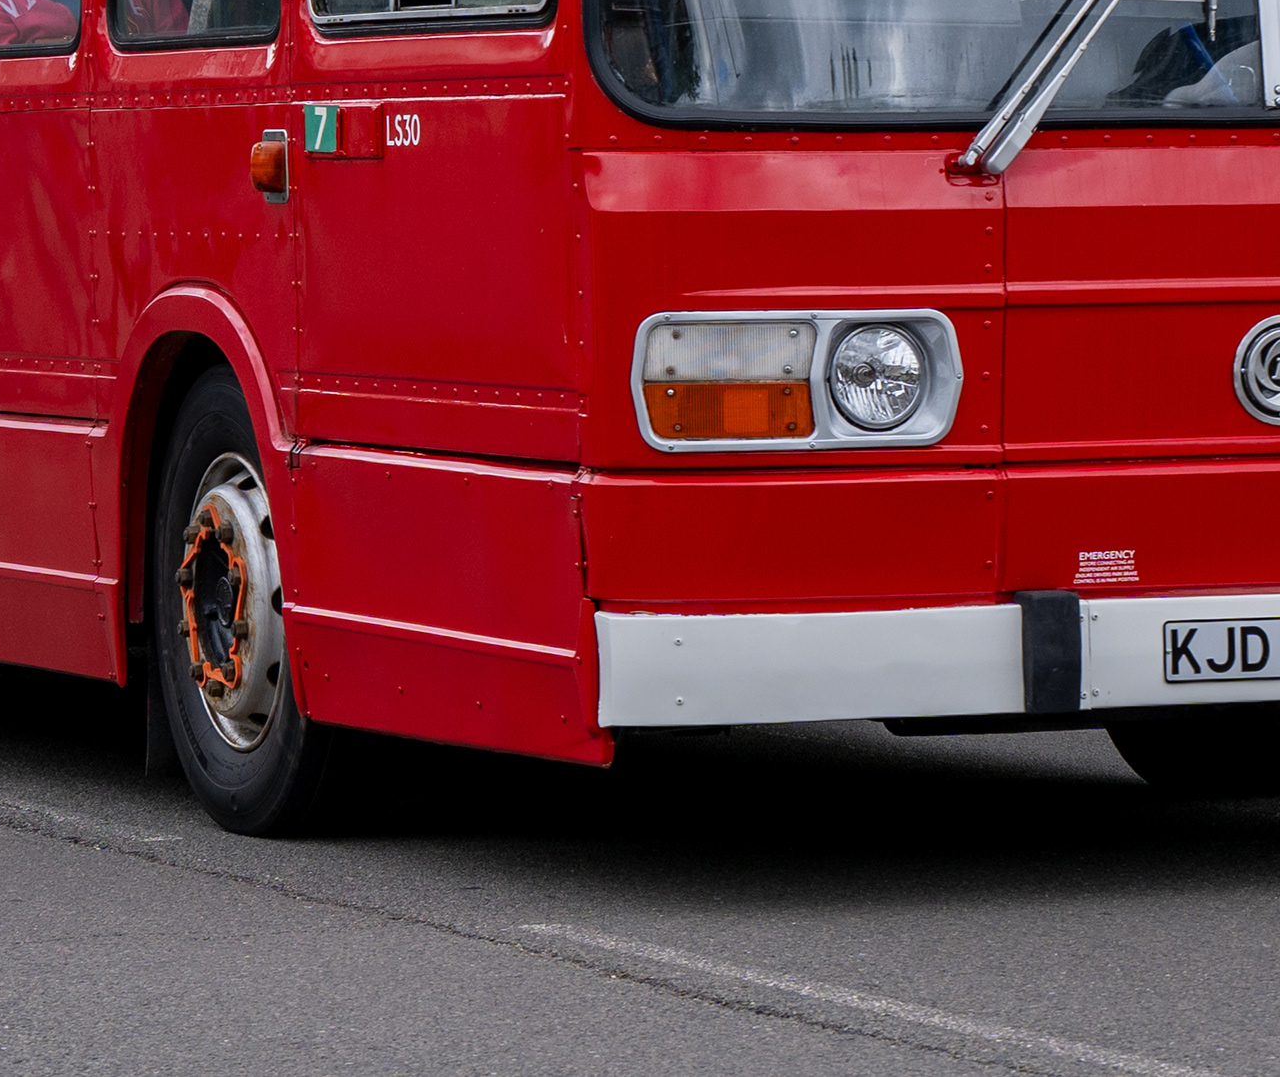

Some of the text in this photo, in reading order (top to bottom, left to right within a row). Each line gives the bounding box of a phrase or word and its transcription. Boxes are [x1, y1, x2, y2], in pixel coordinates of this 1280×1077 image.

[314, 107, 329, 151] 7
[386, 113, 421, 147] LS30
[1079, 550, 1135, 561] EMERGENCY
[1170, 625, 1270, 676] KJD
